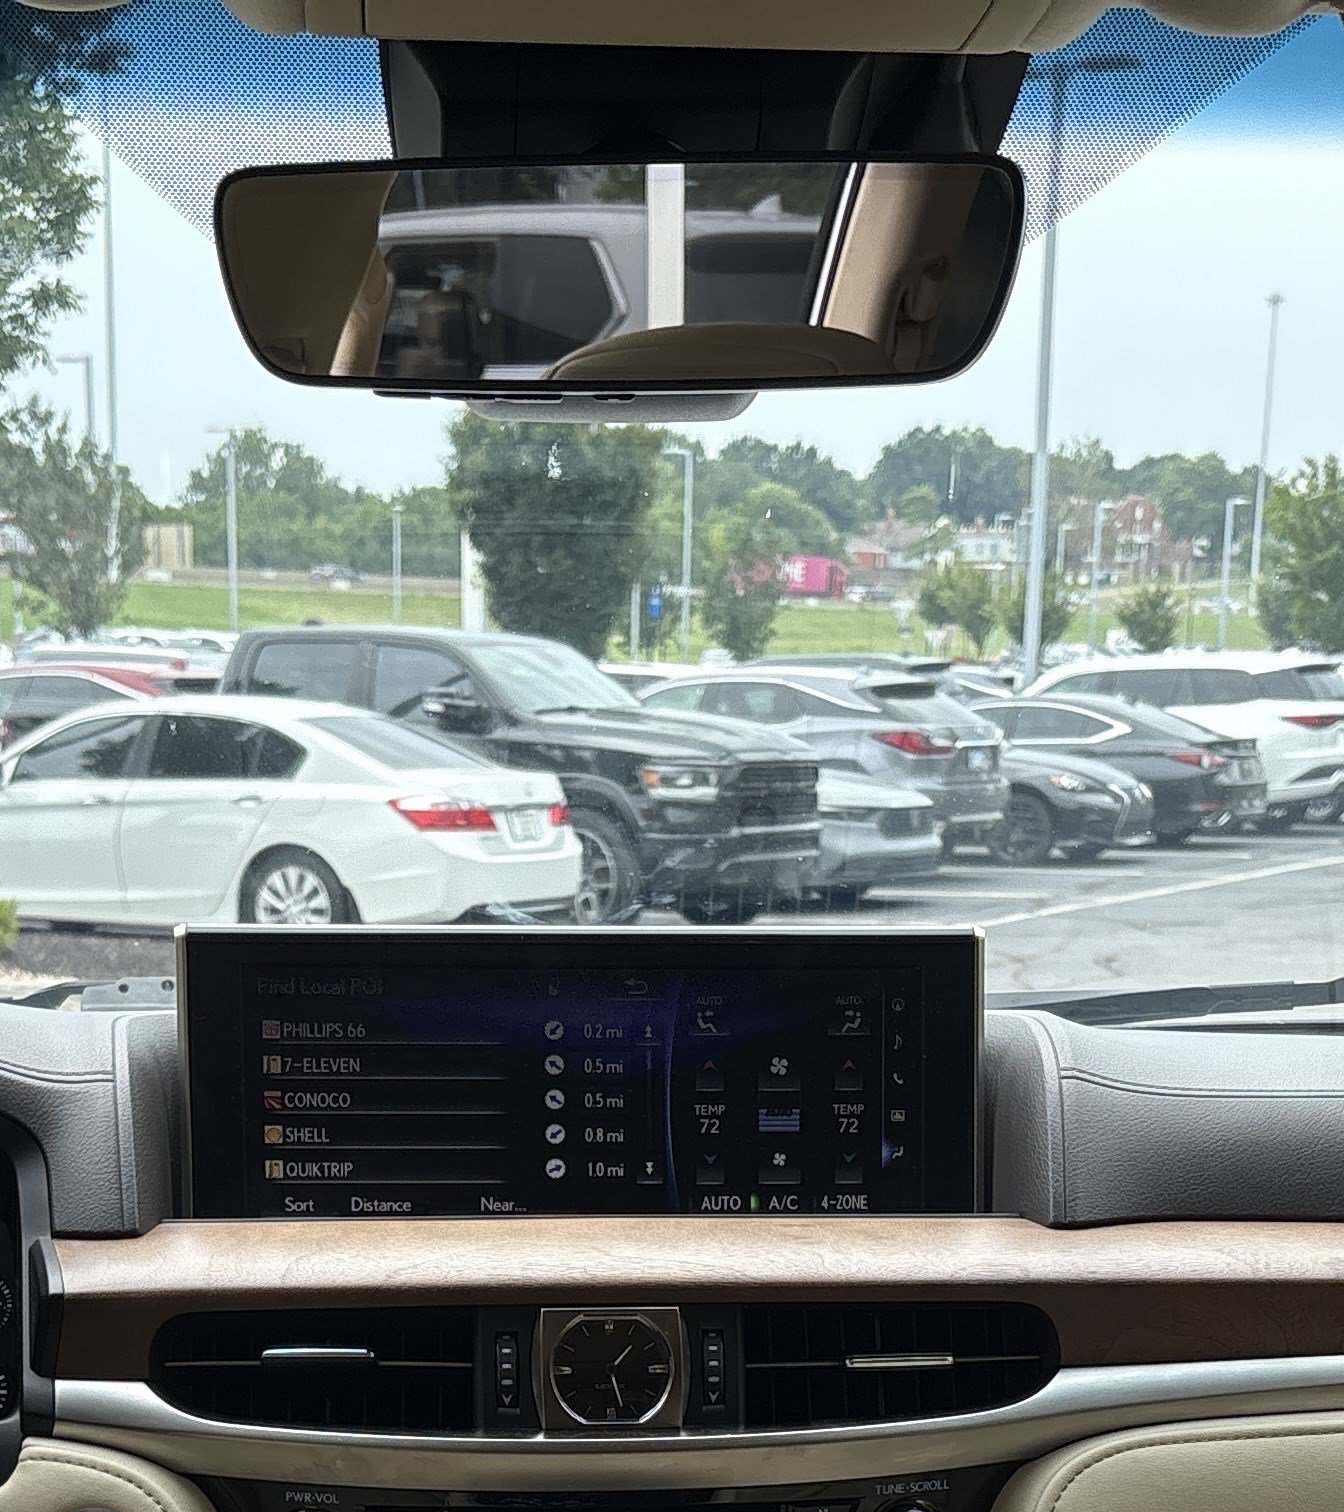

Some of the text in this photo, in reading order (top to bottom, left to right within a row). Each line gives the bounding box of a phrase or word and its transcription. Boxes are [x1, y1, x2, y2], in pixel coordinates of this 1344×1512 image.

[283, 1022, 624, 1039] PHILLIPS 66 0.2 mi
[284, 1058, 624, 1074] 7-ELEVEN 0.5 mi
[284, 1093, 624, 1108] CONOCO 0.5 mi
[694, 1104, 726, 1115] TEMP
[833, 1103, 865, 1115] TEMP
[699, 1120, 720, 1134] 72
[838, 1119, 859, 1133] 72
[285, 1128, 625, 1143] SHELL 0.8 mi
[285, 1162, 625, 1178] QUIKTRIP 1.0 mi
[284, 1197, 315, 1212] Sort
[350, 1197, 412, 1212] Distance
[701, 1195, 868, 1211] AUTO A/C 4-ZONE
